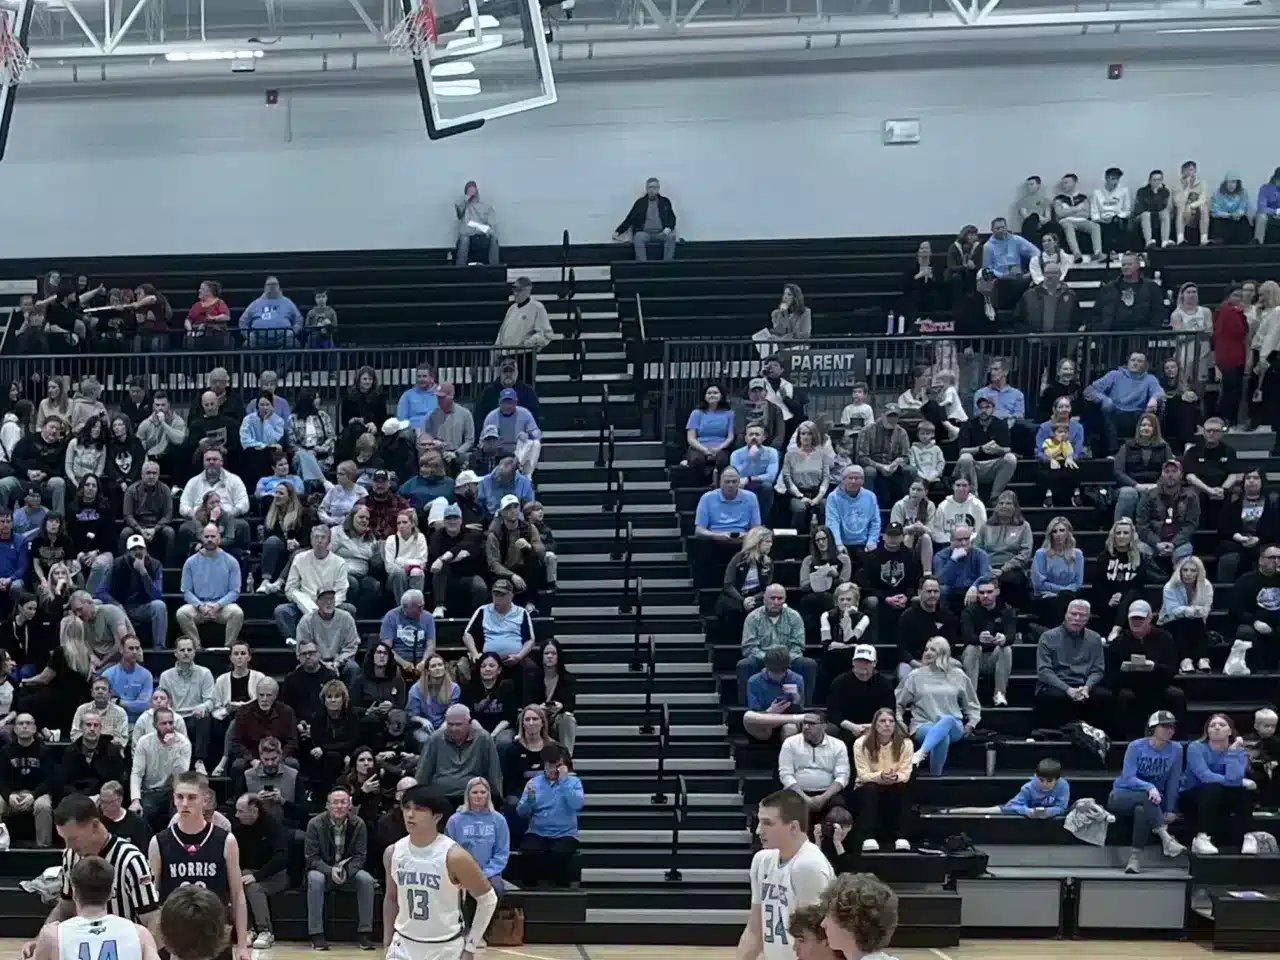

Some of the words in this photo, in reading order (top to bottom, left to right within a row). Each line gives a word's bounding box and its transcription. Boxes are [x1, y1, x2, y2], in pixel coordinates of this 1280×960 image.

[791, 354, 855, 370] PARENT
[790, 371, 856, 387] SEATING
[169, 862, 217, 878] NORRIS
[407, 888, 429, 920] 13
[764, 903, 789, 945] 34
